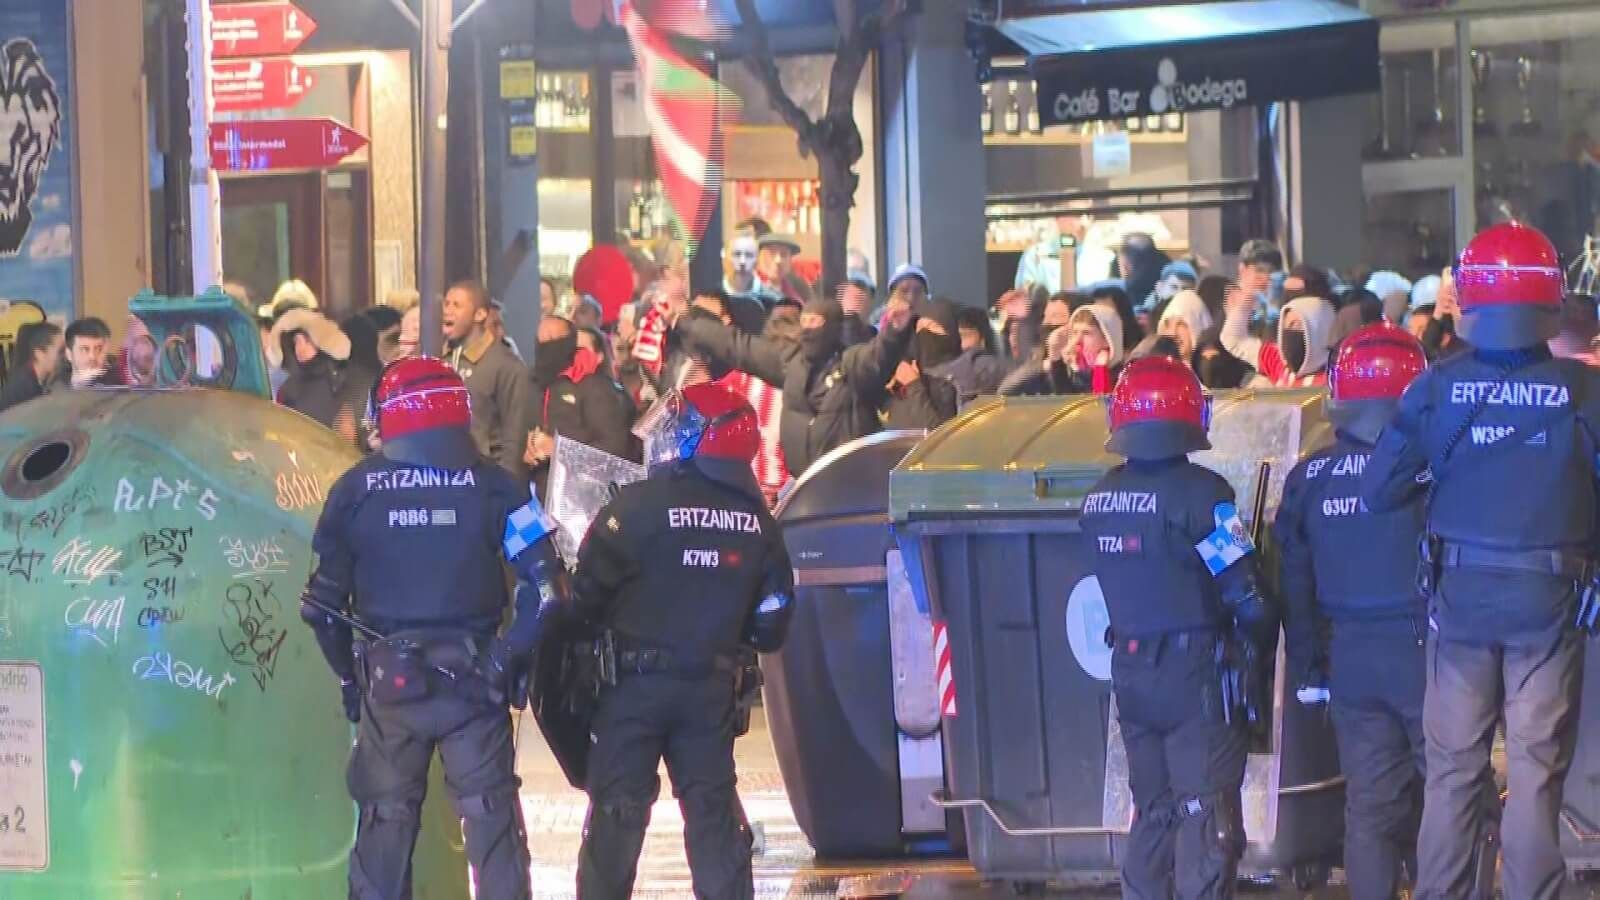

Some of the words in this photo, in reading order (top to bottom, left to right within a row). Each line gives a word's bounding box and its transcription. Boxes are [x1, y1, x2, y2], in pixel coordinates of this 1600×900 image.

[1054, 88, 1099, 119] Café
[1107, 88, 1140, 114] Bar
[1451, 381, 1569, 407] ERTZAINTZA
[1083, 491, 1157, 515] ERTZAINTZA
[668, 507, 762, 535] ERTZAINTZA
[682, 549, 719, 568] K7W3
[14, 804, 26, 833] 2
